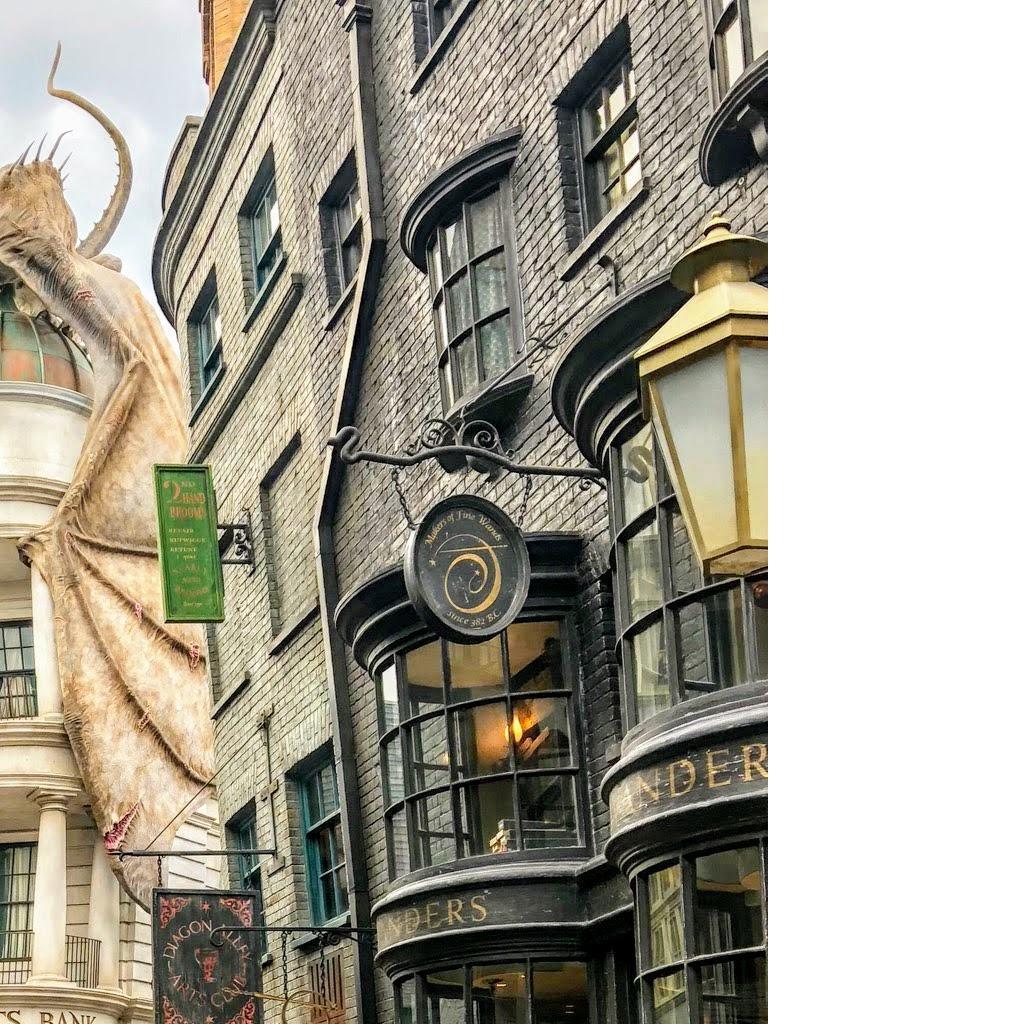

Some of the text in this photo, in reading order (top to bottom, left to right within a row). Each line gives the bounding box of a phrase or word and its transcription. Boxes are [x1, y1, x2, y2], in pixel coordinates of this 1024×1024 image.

[446, 511, 455, 523] of
[163, 919, 212, 959] DIAGON
[168, 974, 207, 1006] ARTS
